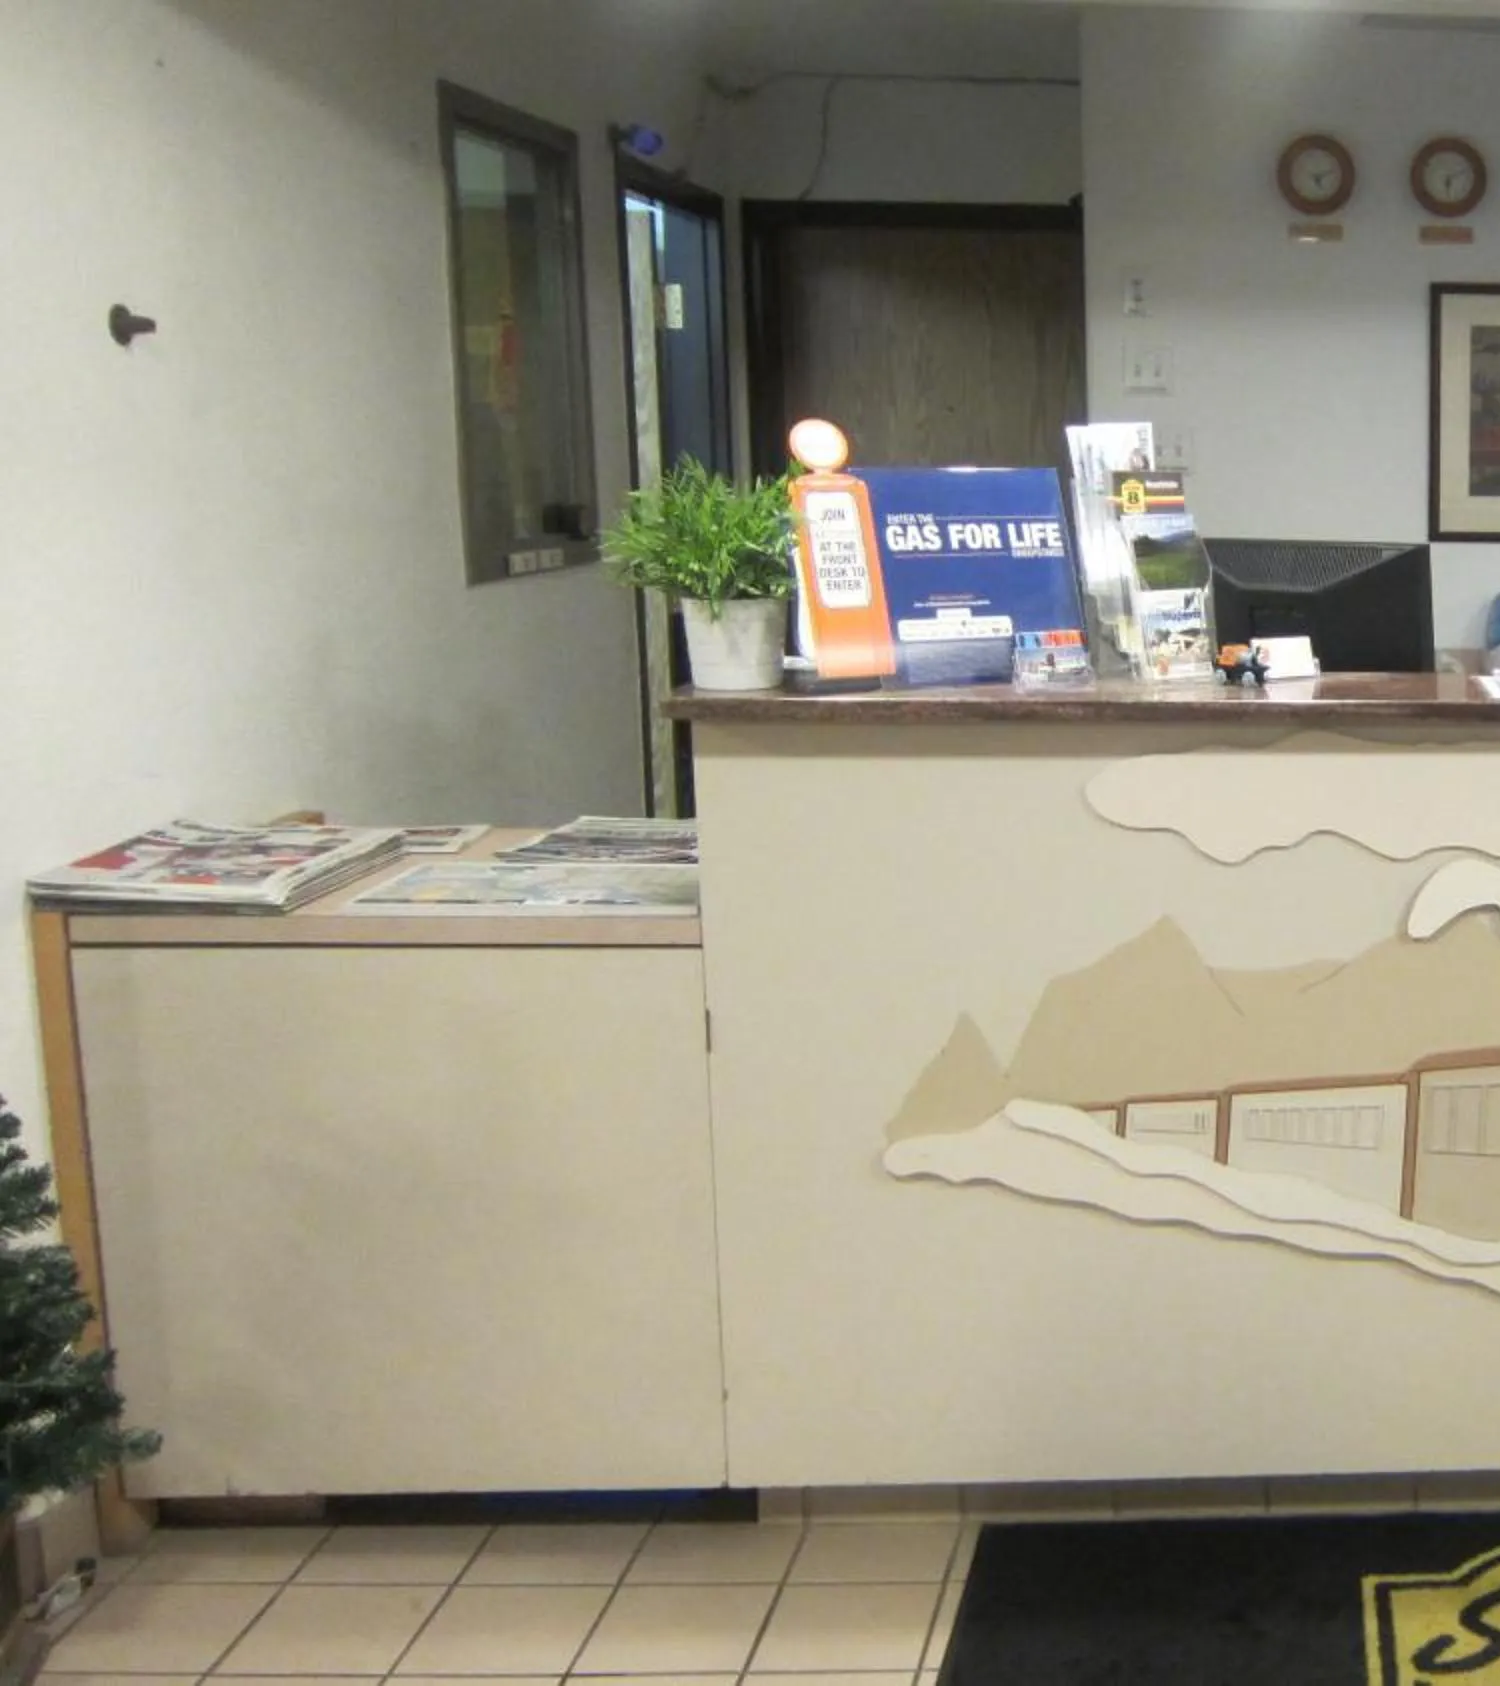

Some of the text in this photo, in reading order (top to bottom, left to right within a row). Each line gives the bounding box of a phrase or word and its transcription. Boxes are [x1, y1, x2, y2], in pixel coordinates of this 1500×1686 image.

[820, 507, 846, 521] JOIN
[886, 522, 1063, 551] GAS FOR LIFE
[820, 541, 832, 552] AT
[821, 553, 858, 565] FRONT
[819, 566, 866, 578] DESK TO
[826, 579, 862, 591] ENTER
